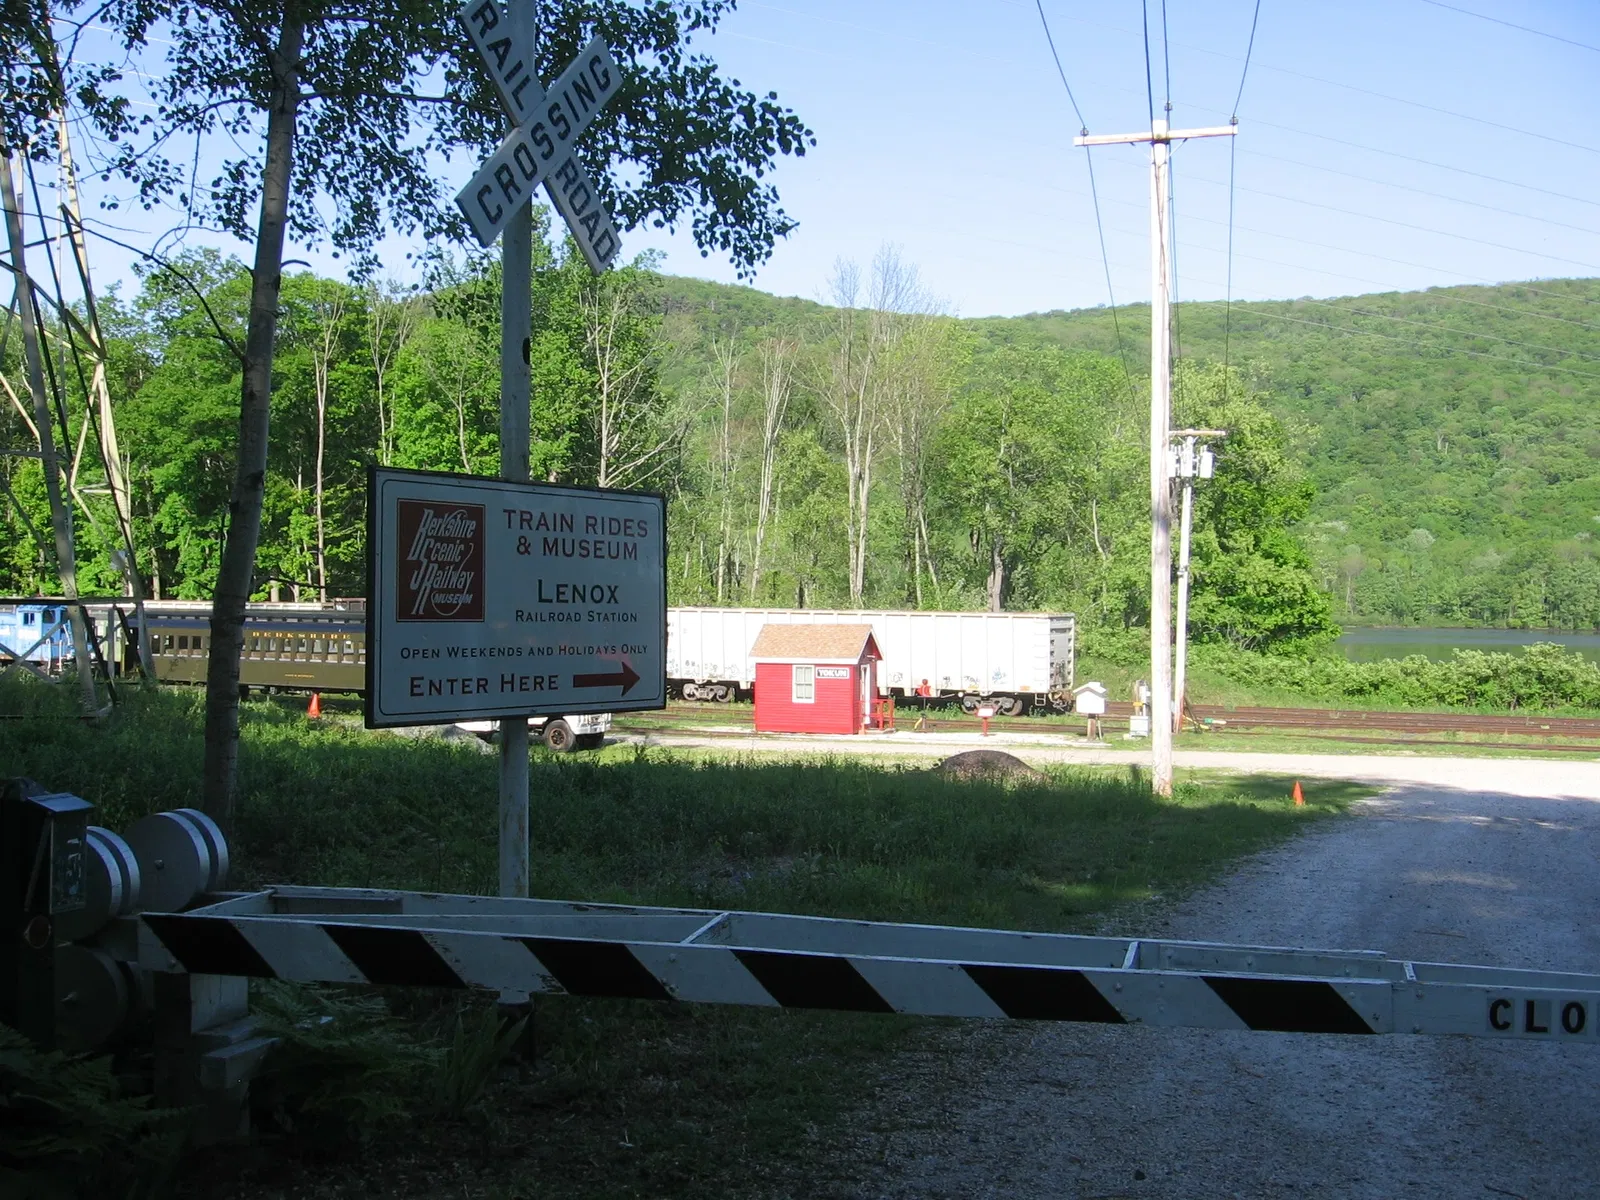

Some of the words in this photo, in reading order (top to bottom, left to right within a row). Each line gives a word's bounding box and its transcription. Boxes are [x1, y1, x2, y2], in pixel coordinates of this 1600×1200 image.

[470, 1, 531, 111] RAIL
[555, 157, 616, 263] ROAD
[476, 54, 611, 225] CROSSING
[503, 509, 574, 533] TRAIN
[585, 515, 648, 538] RIDES
[517, 536, 531, 556] &
[543, 537, 638, 561] MUSEUM
[434, 593, 473, 605] MUSEUM
[537, 579, 619, 604] LENOX
[515, 610, 582, 622] RAILROAD
[587, 611, 638, 623] STATION
[400, 647, 440, 660] OPEN
[446, 646, 523, 658] WEEKENDS
[528, 647, 553, 656] AND
[558, 644, 617, 656] HOLIDAYS
[621, 644, 648, 655] ONLY
[410, 676, 489, 697] ENTER
[500, 673, 560, 693] HERE
